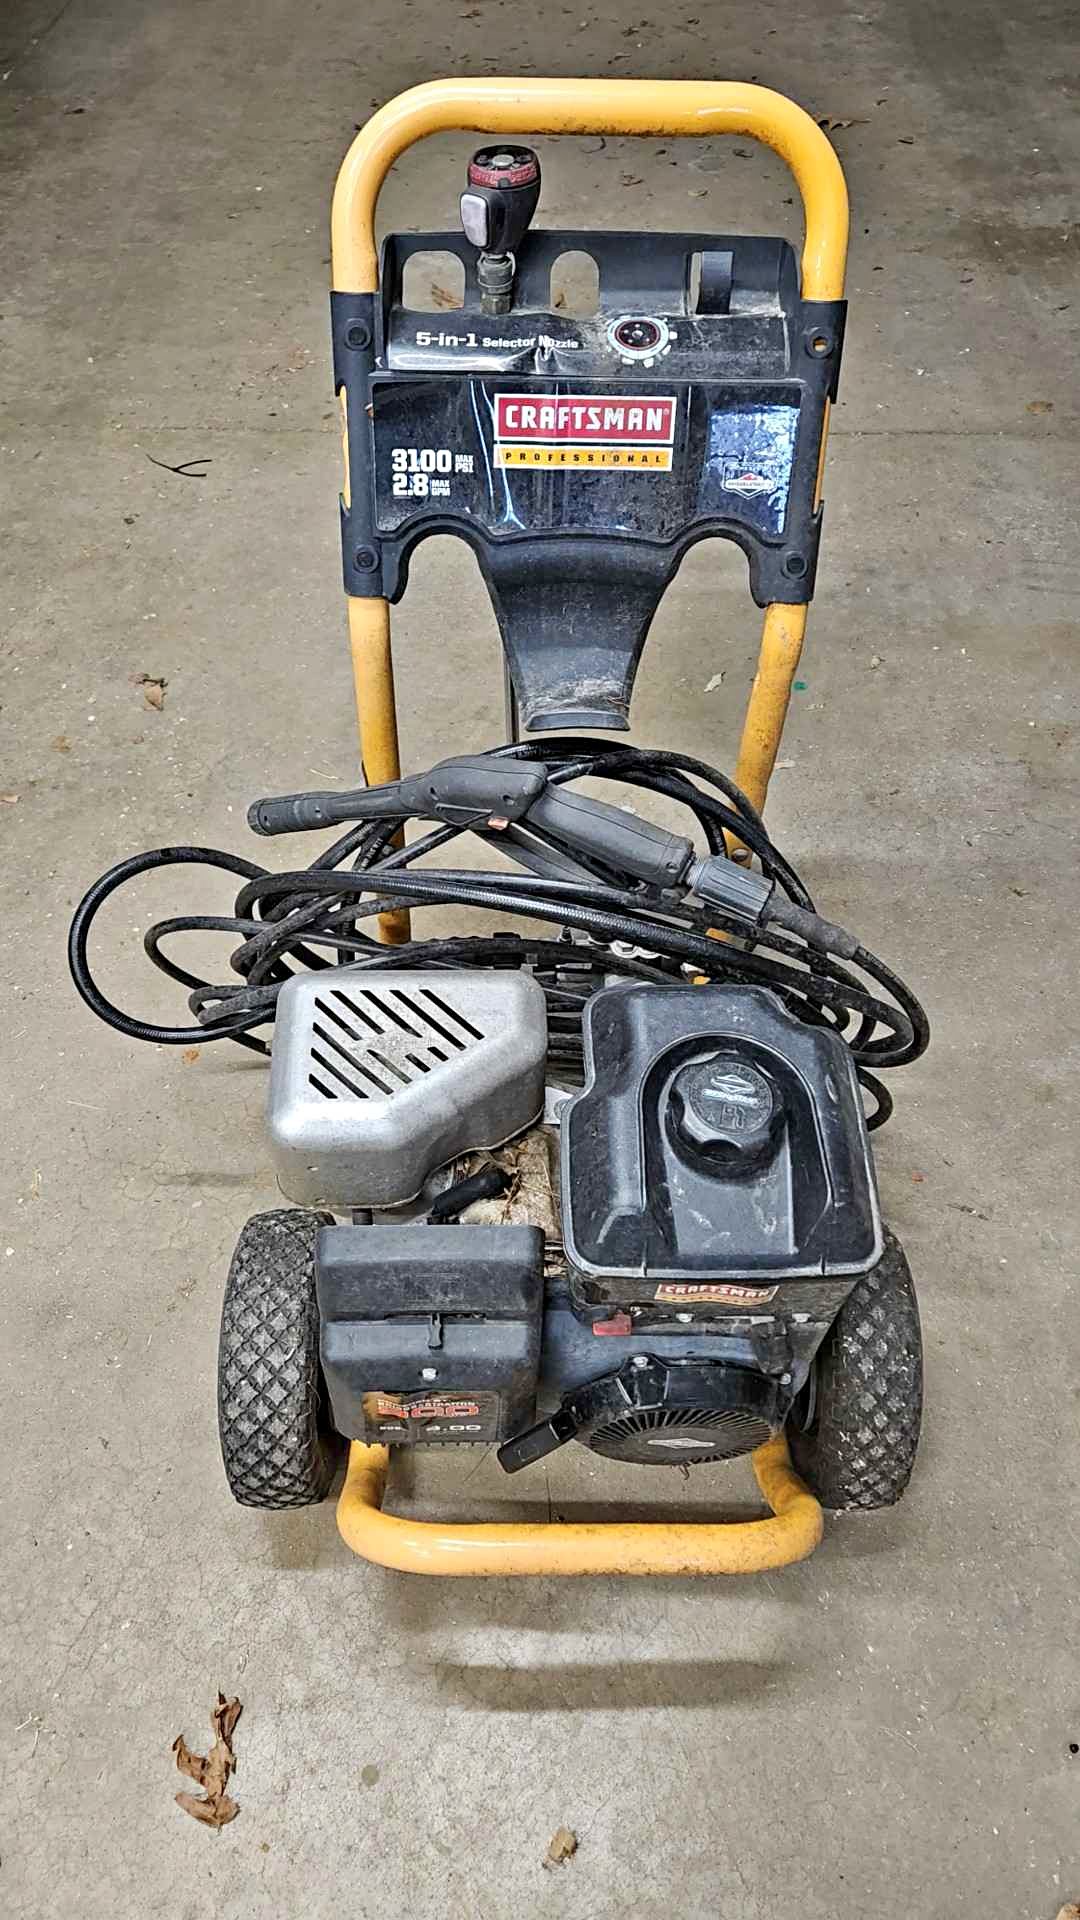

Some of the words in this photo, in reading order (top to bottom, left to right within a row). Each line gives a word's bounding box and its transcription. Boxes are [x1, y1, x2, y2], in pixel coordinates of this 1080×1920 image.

[416, 331, 478, 347] 5-in-1
[482, 336, 535, 348] Selector
[538, 335, 579, 349] Nozzle
[505, 405, 663, 431] CRAFTSMAN
[391, 448, 452, 473] 3100
[455, 454, 474, 463] MAX
[505, 452, 662, 463] PROFESSIONAL
[455, 463, 474, 473] PSI
[392, 473, 429, 496] 2.8
[431, 479, 450, 488] MAX
[431, 488, 451, 496] GPM
[665, 1284, 770, 1298] CRAFTSMAN
